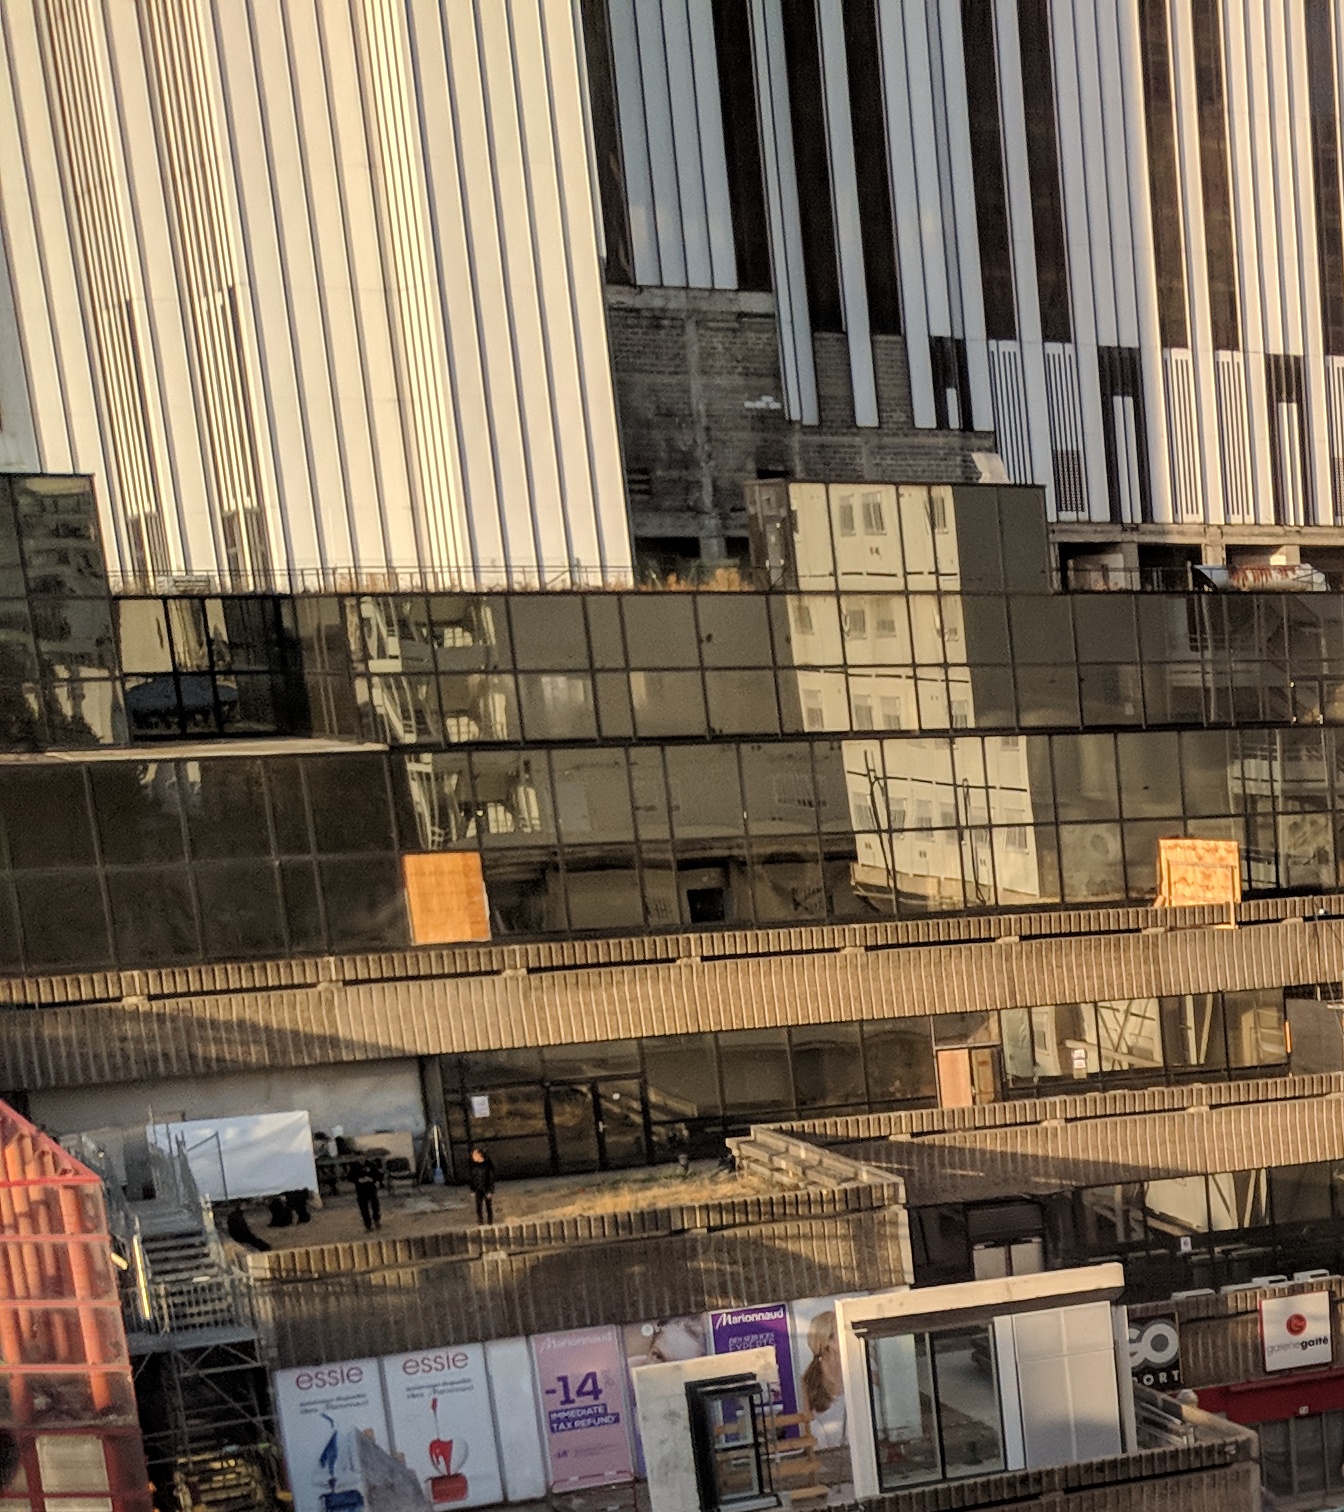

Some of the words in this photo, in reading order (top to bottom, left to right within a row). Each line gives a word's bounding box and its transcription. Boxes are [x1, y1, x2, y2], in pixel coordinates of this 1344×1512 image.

[715, 1307, 784, 1329] Marionnaud
[402, 1352, 469, 1375] essie
[295, 1366, 363, 1391] essie
[552, 1421, 573, 1431] TAX
